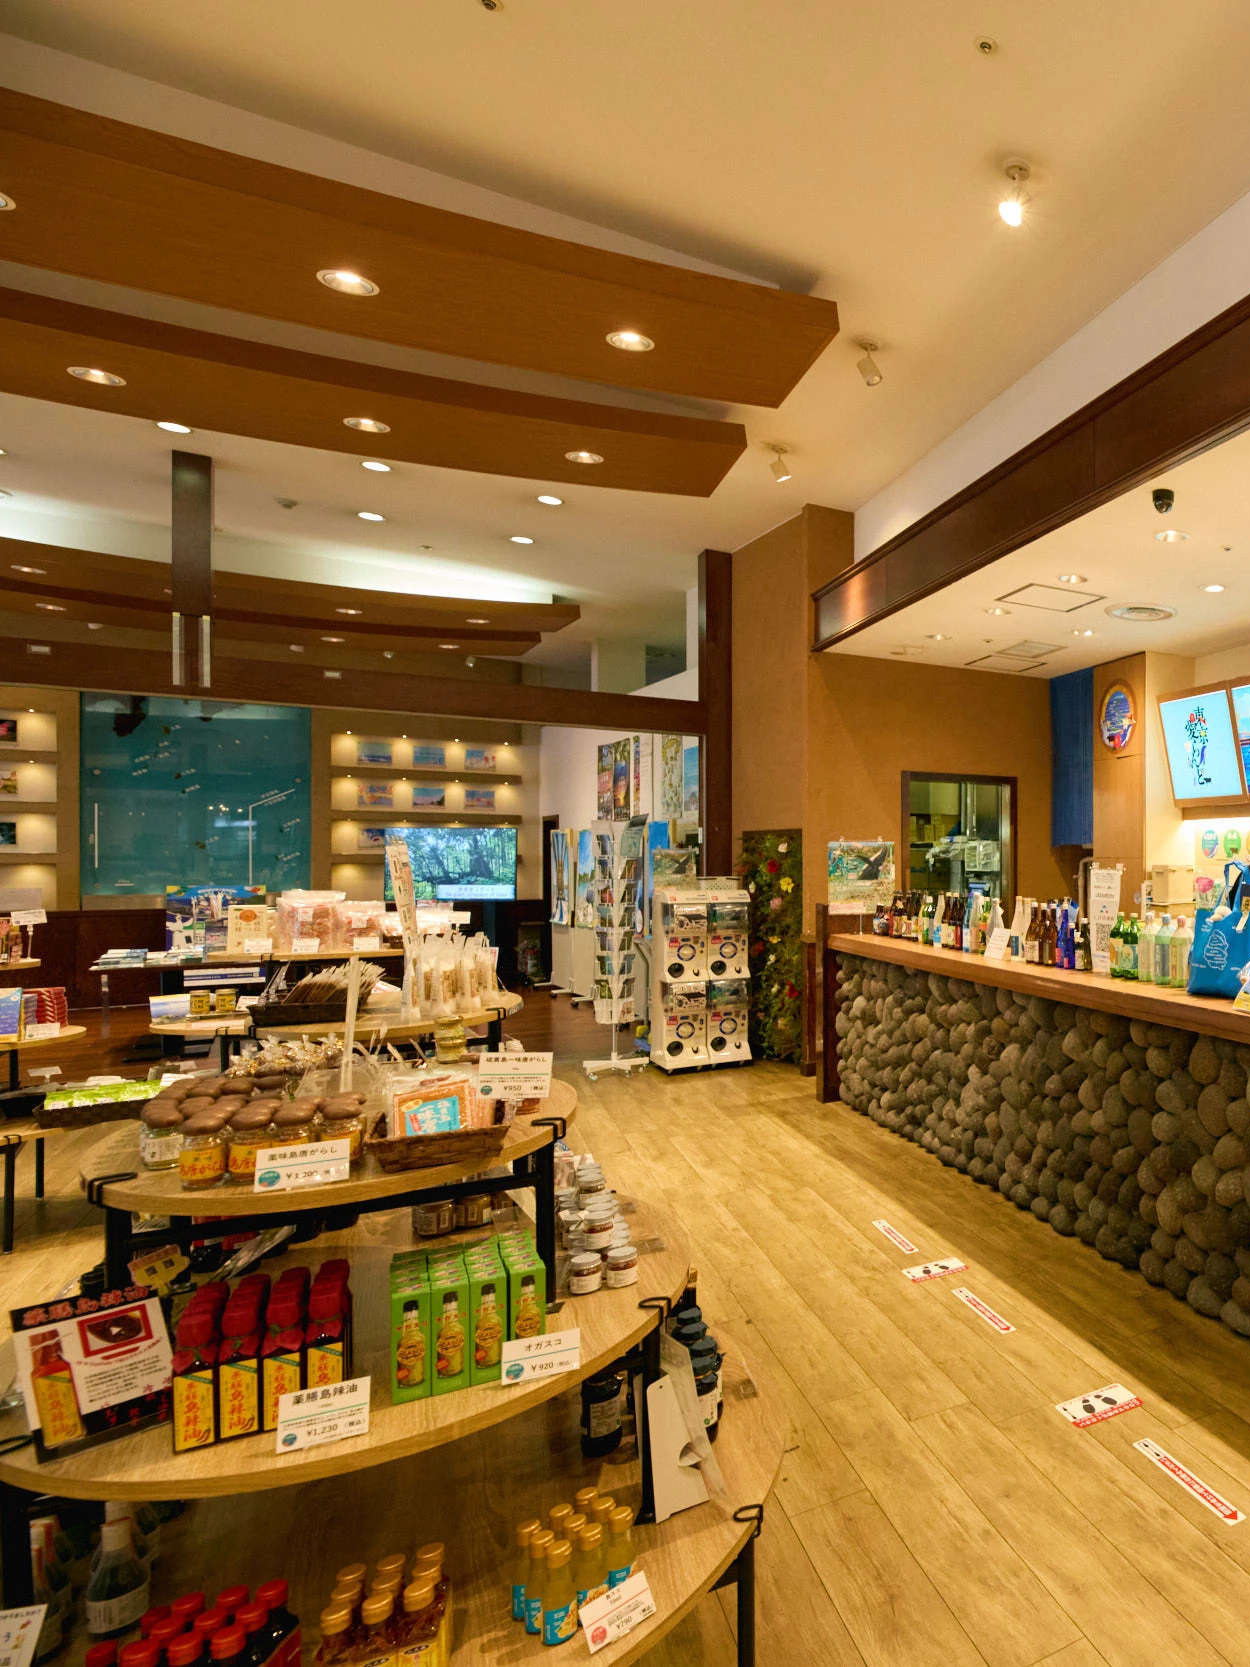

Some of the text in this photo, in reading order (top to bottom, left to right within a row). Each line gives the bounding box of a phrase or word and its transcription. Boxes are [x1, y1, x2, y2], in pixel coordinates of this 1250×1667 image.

[485, 1056, 548, 1064] 硫黄島一味唐がらし
[268, 1146, 339, 1162] 薬味島唐がらし
[515, 1294, 544, 1305] オガスコ
[475, 1303, 505, 1314] オガスコ
[436, 1311, 467, 1322] オガスコ
[396, 1320, 428, 1331] オガスコ
[524, 1338, 562, 1352] オガスコ
[531, 1361, 554, 1372] ¥920
[292, 1383, 358, 1407] 薬膳島辣油
[307, 1423, 338, 1438] ¥1,230
